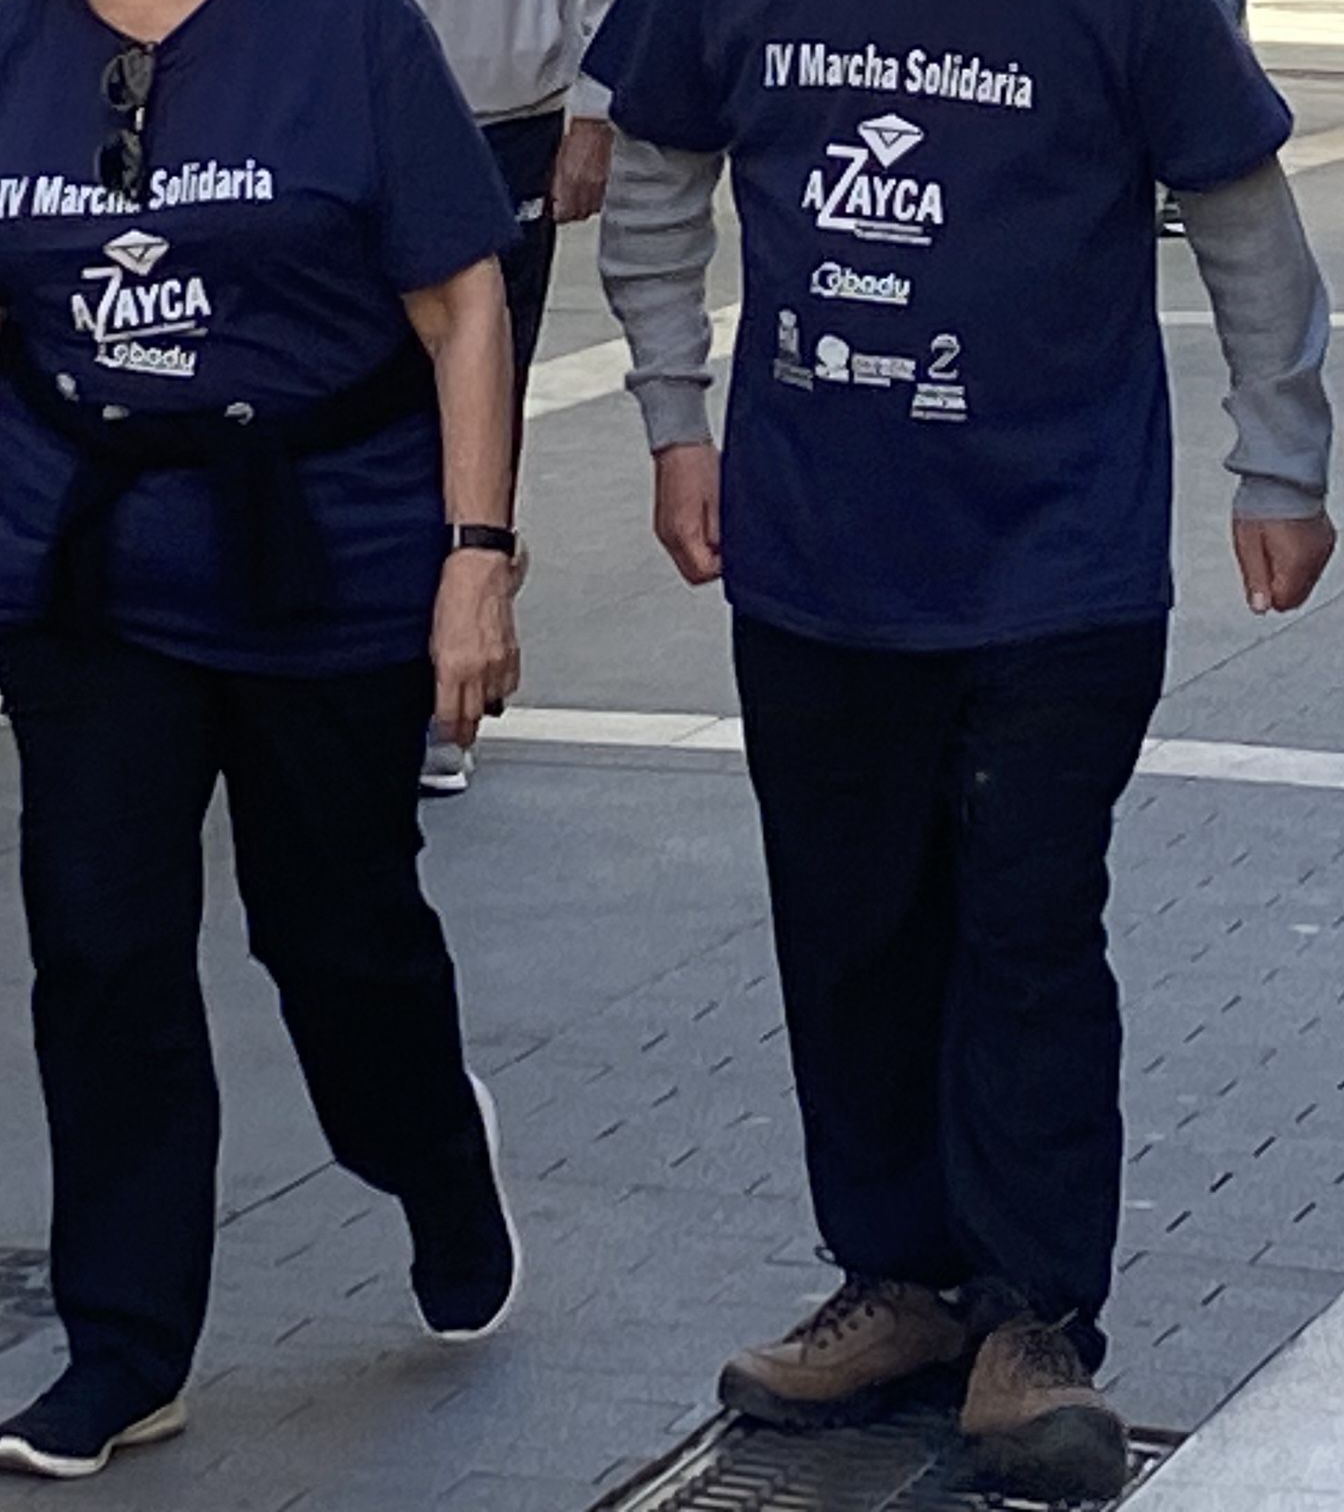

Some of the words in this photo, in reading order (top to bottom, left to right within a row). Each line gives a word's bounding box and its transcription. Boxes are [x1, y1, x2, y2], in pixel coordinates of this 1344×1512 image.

[763, 43, 794, 88] IV
[798, 44, 899, 90] Marcha
[905, 49, 1033, 109] Solidaria
[149, 159, 273, 210] Solidaria
[801, 143, 944, 232] AZAYCA
[71, 266, 211, 344] AZAYCA
